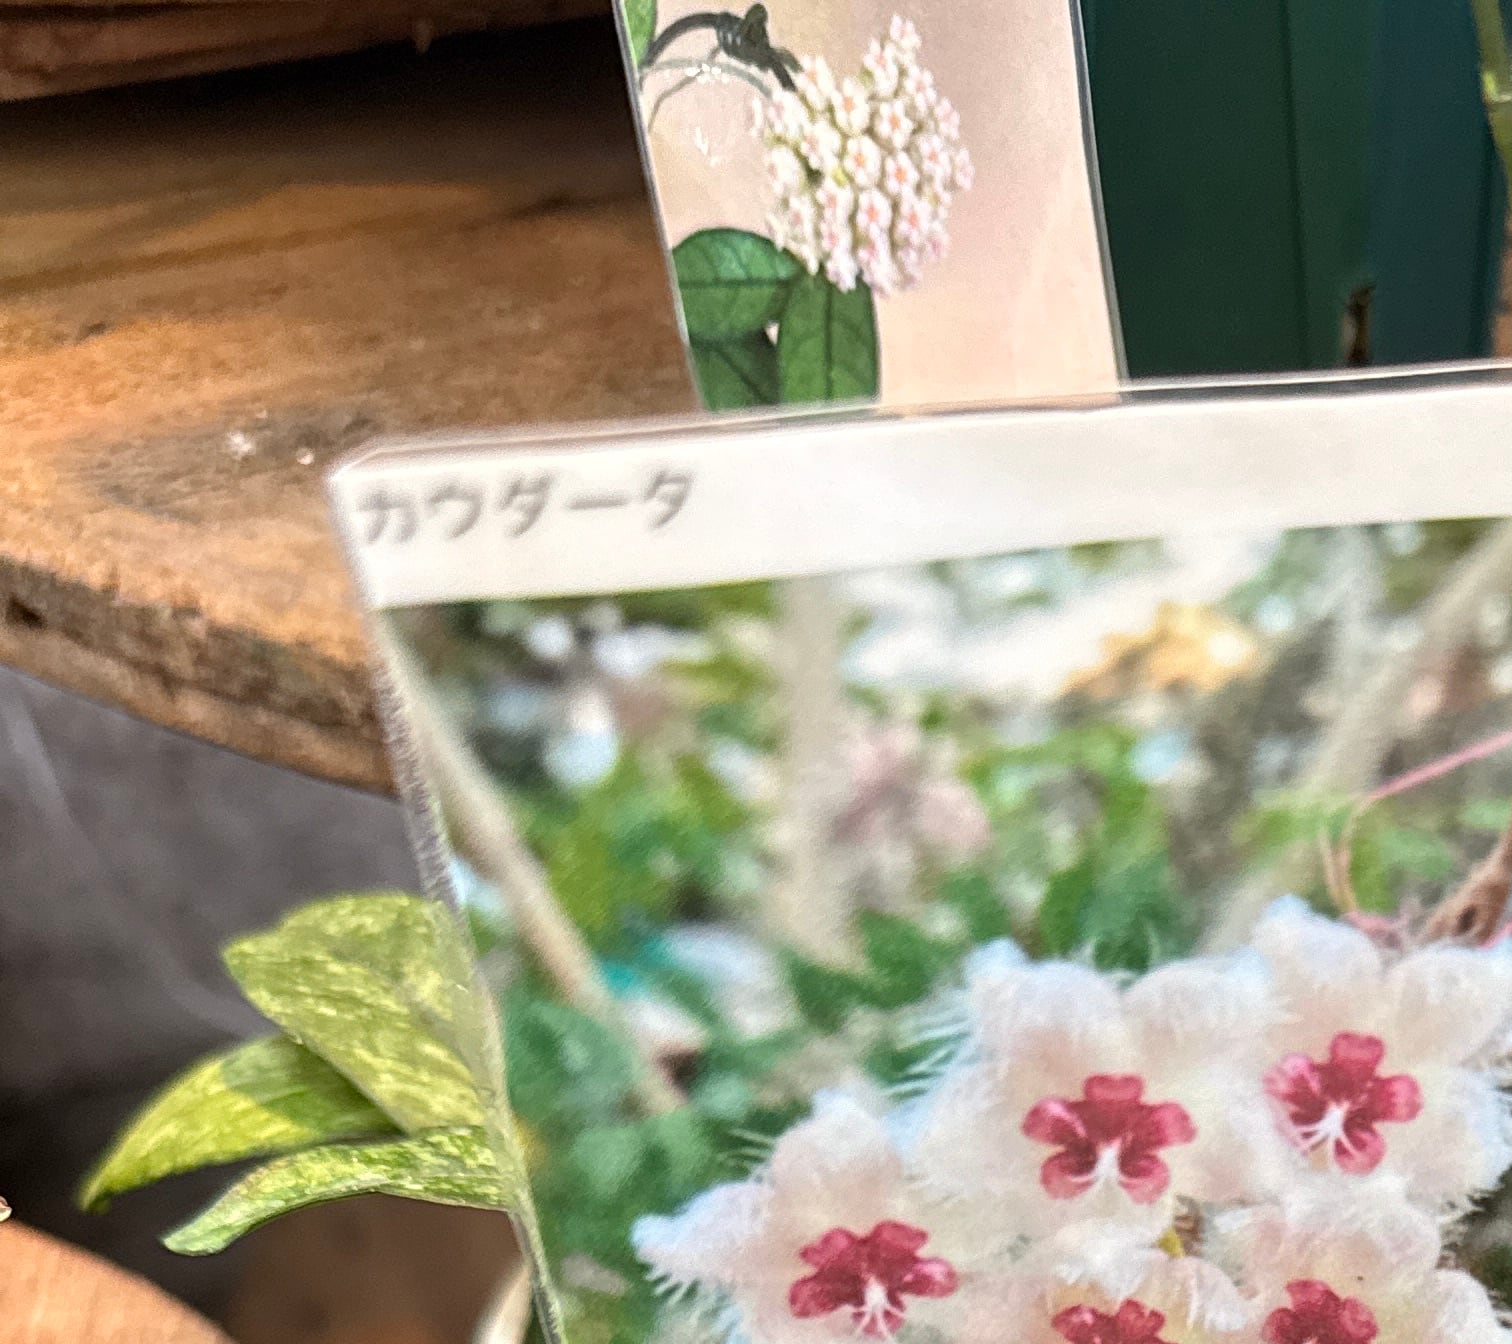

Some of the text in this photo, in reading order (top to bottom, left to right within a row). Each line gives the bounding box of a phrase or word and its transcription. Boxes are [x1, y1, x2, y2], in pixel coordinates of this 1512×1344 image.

[357, 469, 696, 543] カウダータ
